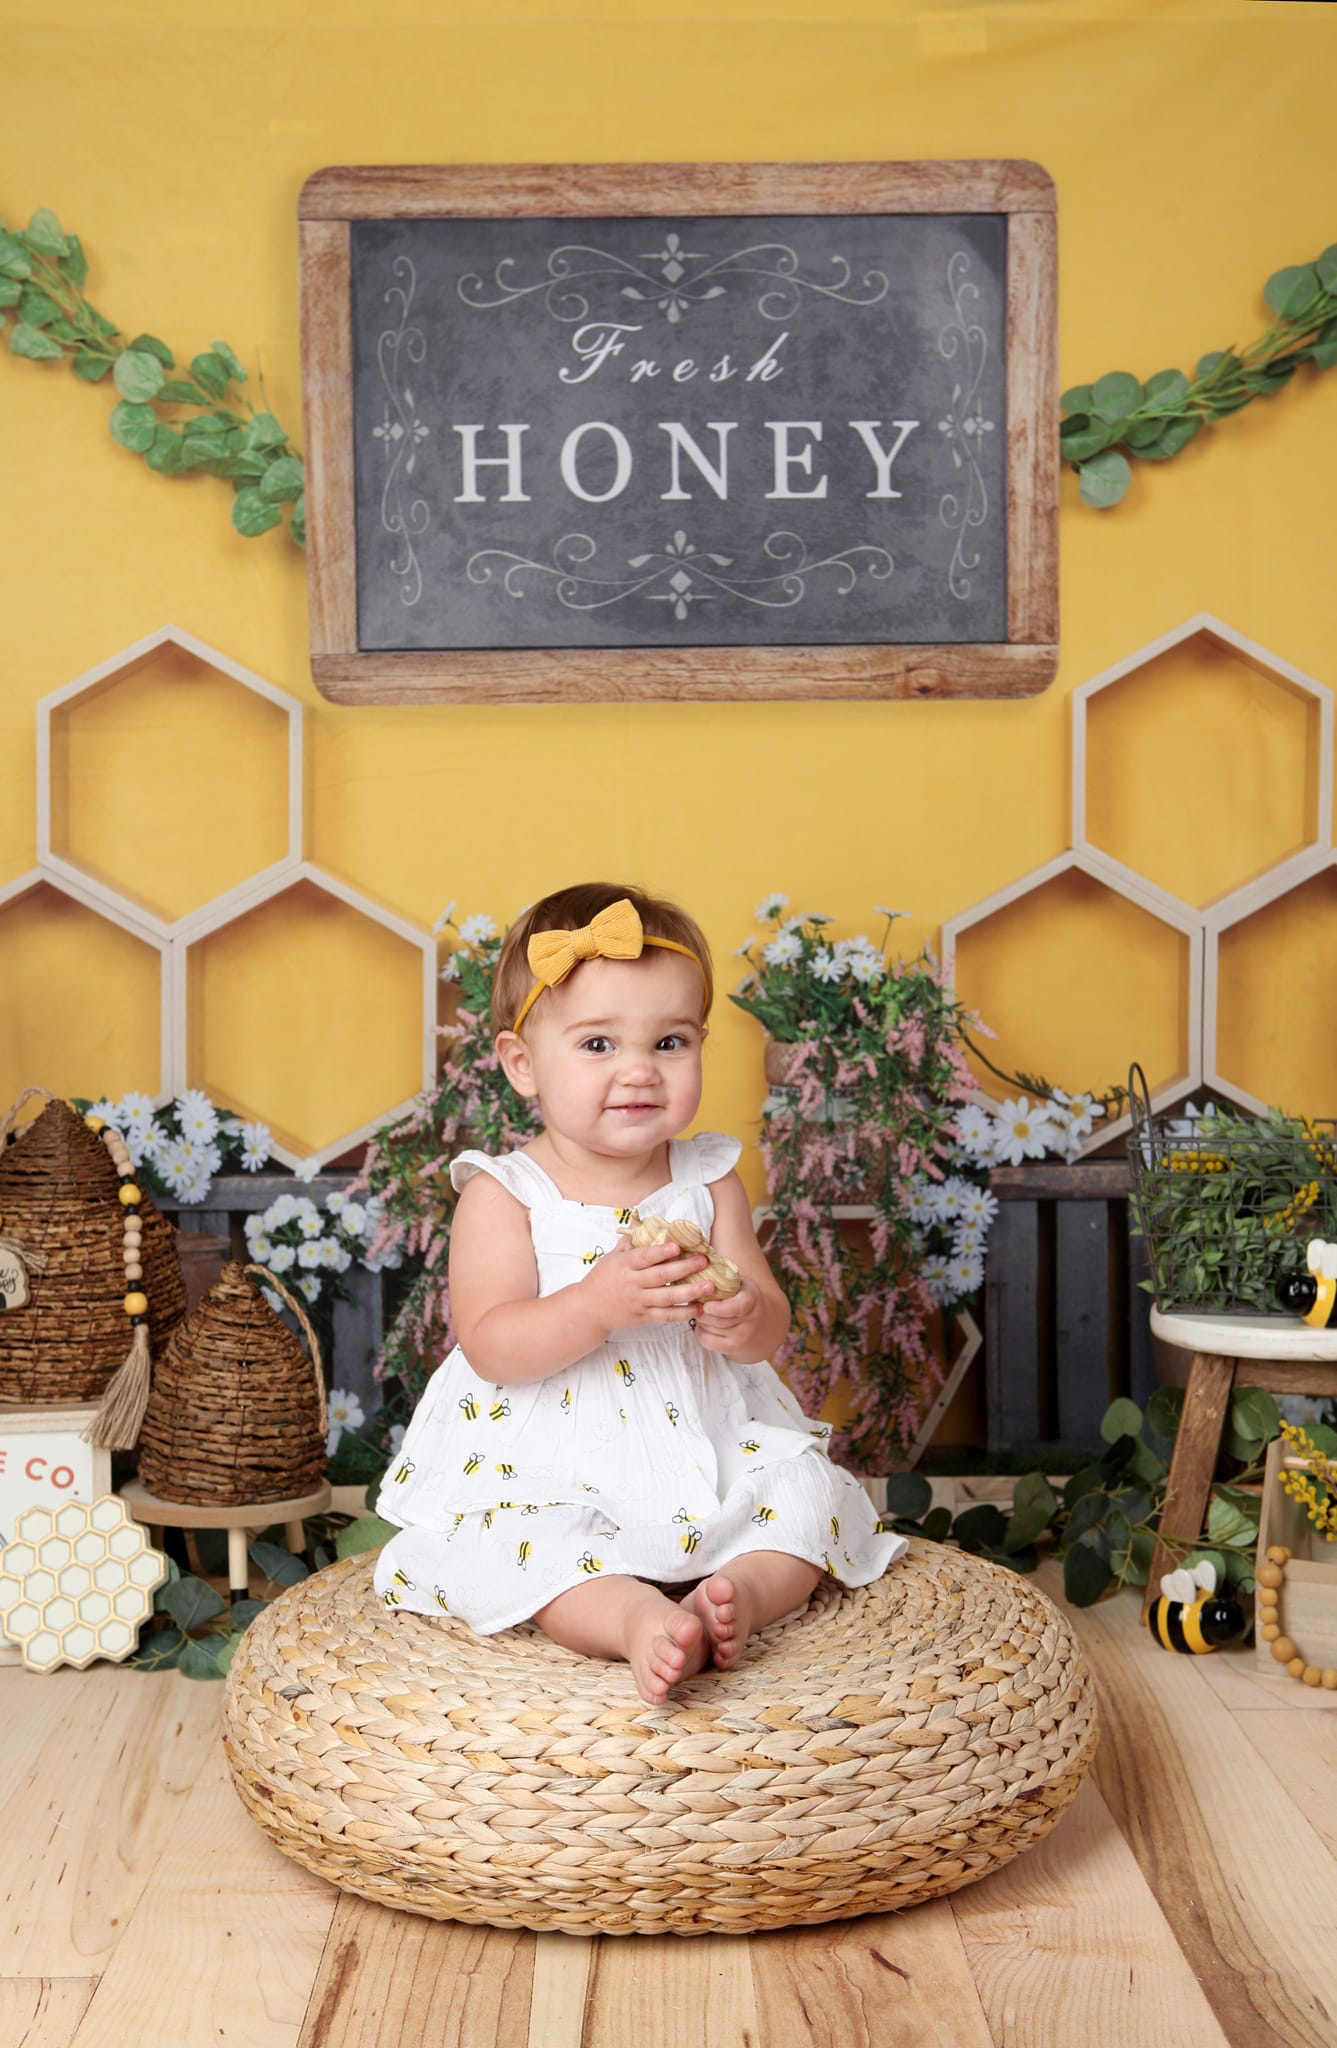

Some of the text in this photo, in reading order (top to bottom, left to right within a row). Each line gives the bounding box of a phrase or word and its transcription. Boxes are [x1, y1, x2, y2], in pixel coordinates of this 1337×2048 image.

[558, 322, 789, 384] Fresh
[453, 420, 920, 503] HONEY
[25, 1457, 79, 1496] CO.
